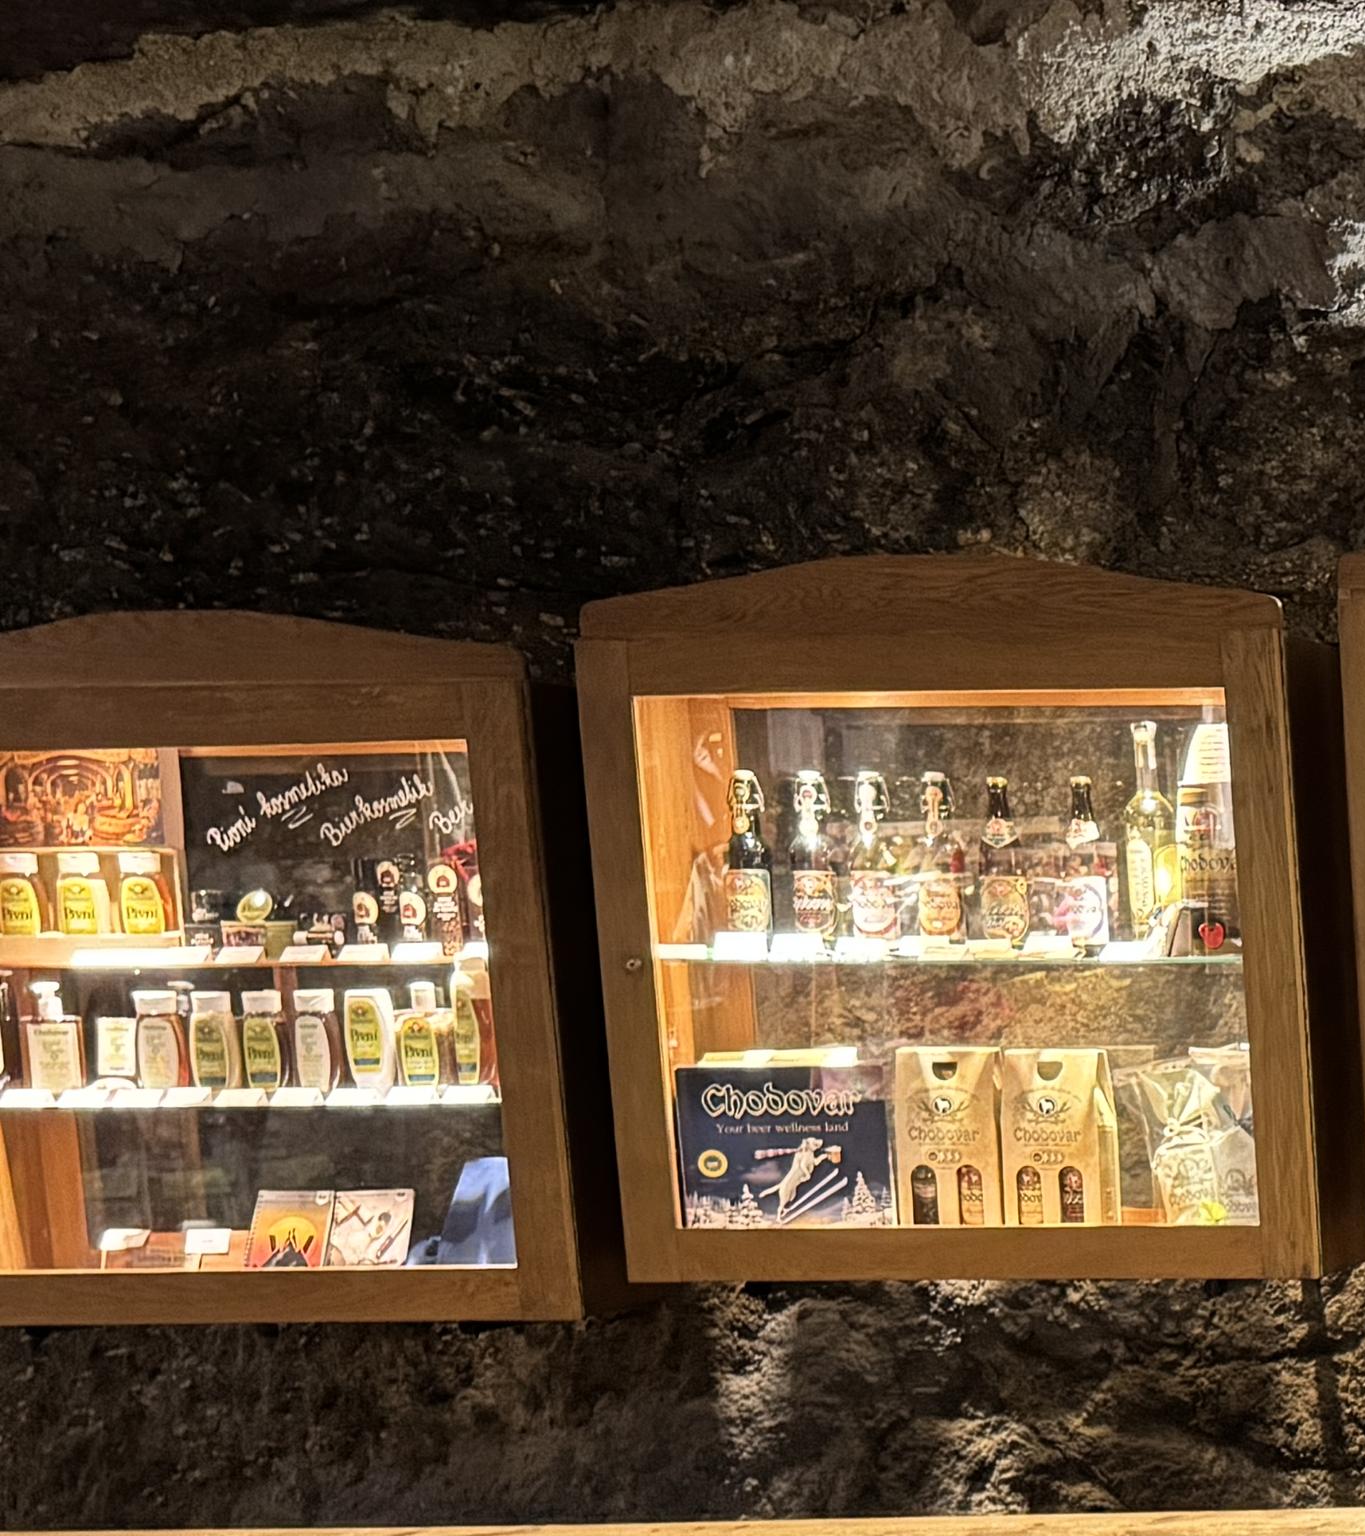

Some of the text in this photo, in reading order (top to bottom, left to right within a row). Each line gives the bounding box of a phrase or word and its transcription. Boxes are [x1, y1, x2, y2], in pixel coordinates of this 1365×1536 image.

[206, 762, 348, 852] Pivní kosmetika
[320, 773, 434, 847] Bierkosmetik
[701, 1082, 863, 1120] Chodovar
[716, 1122, 743, 1134] Your
[775, 1122, 822, 1133] wellness
[824, 1121, 849, 1132] land
[908, 1125, 980, 1142] Chodovar
[1013, 1125, 1082, 1143] Chodovar
